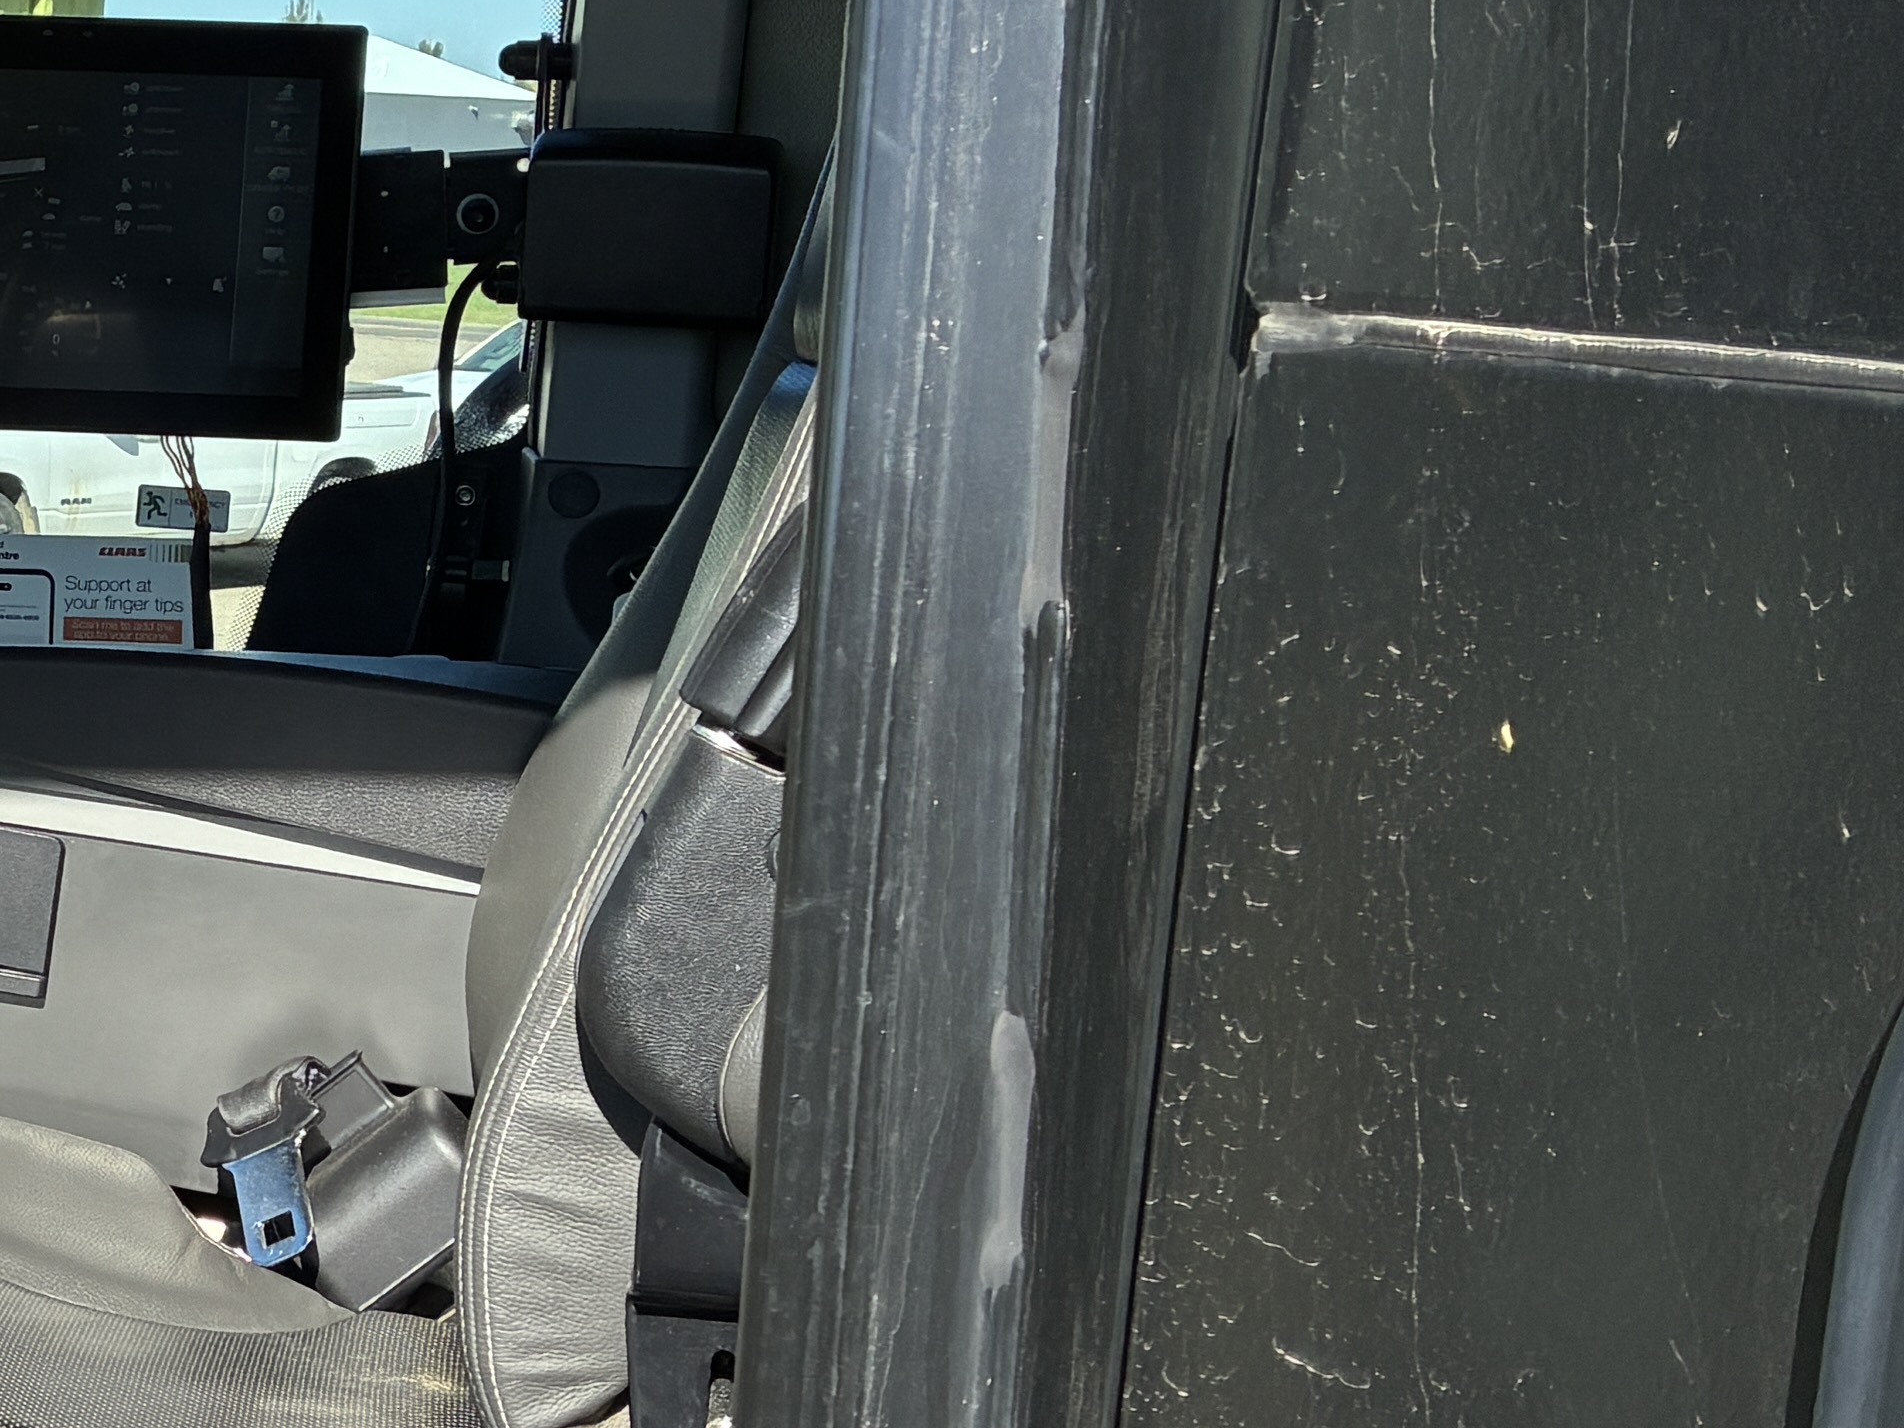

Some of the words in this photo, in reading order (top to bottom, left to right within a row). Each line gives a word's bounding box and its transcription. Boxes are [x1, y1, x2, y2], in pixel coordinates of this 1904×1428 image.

[98, 546, 148, 557] CLAAS
[64, 575, 132, 594] Support
[136, 578, 153, 593] at
[63, 597, 99, 614] your
[104, 594, 150, 615] finger
[155, 597, 185, 614] tips
